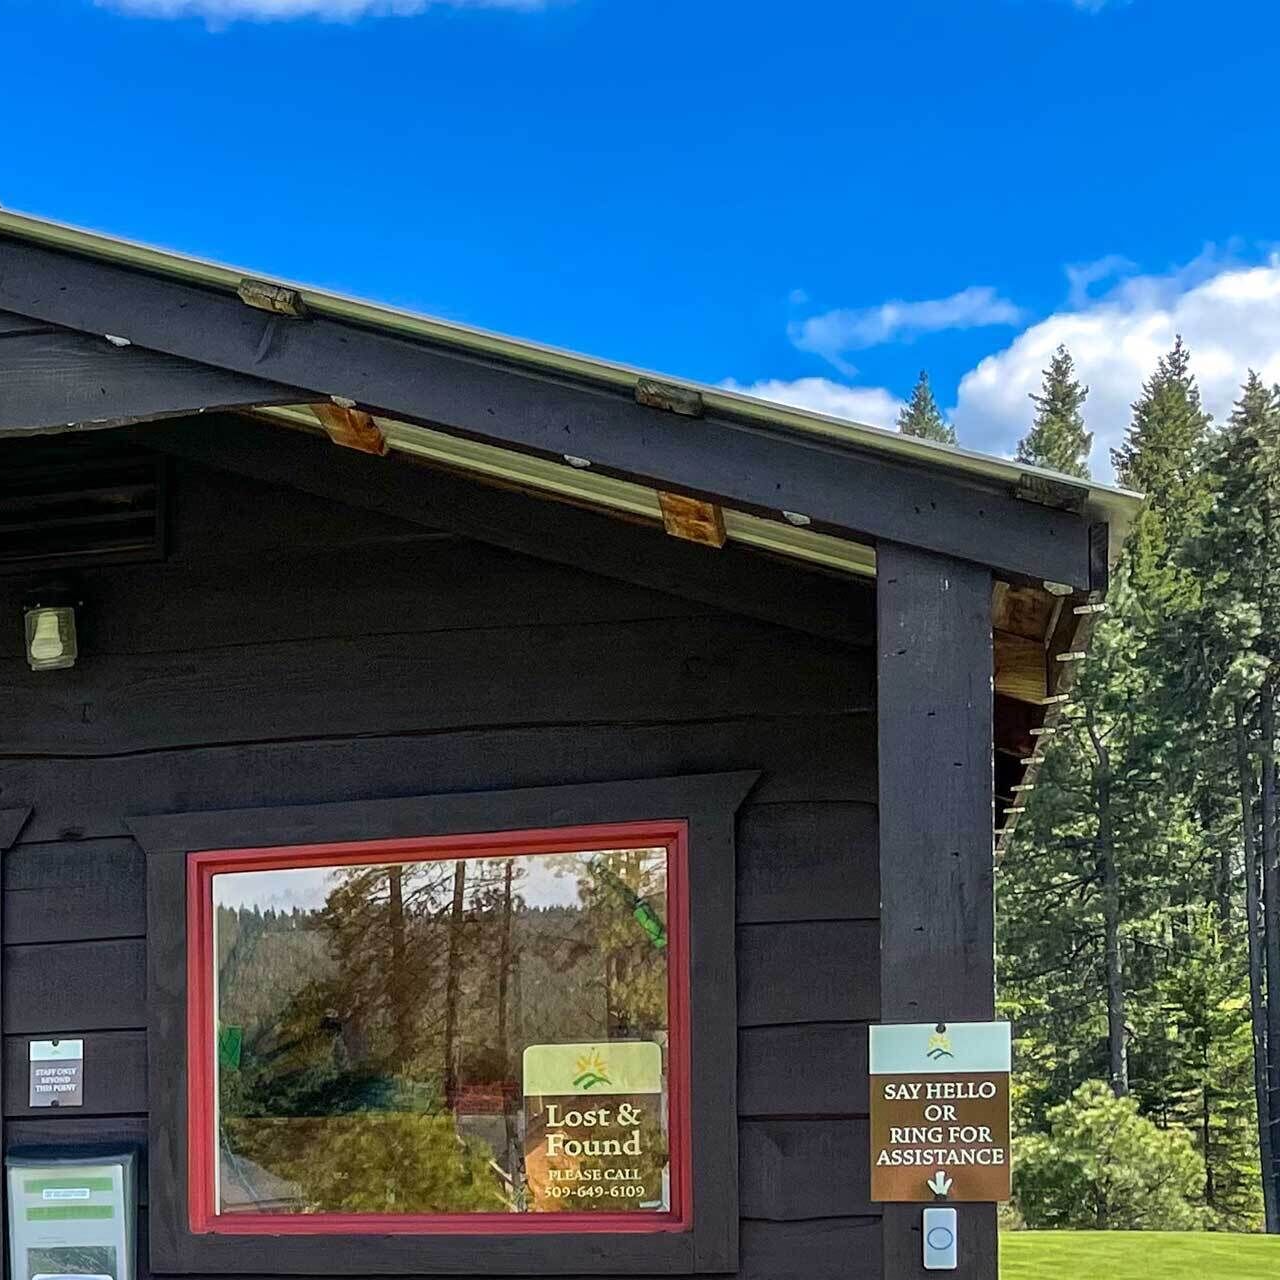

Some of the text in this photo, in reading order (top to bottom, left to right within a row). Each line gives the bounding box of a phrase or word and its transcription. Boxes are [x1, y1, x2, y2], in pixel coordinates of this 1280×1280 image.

[884, 1081, 996, 1100] SAY HELLO
[545, 1103, 641, 1128] Lost &
[924, 1105, 957, 1121] OR
[545, 1130, 642, 1156] Found
[890, 1126, 993, 1144] RING FOR
[877, 1148, 1004, 1166] ASSISTANCE
[548, 1168, 642, 1181] PLEASE CALL
[544, 1185, 645, 1198] 509-649-6109
